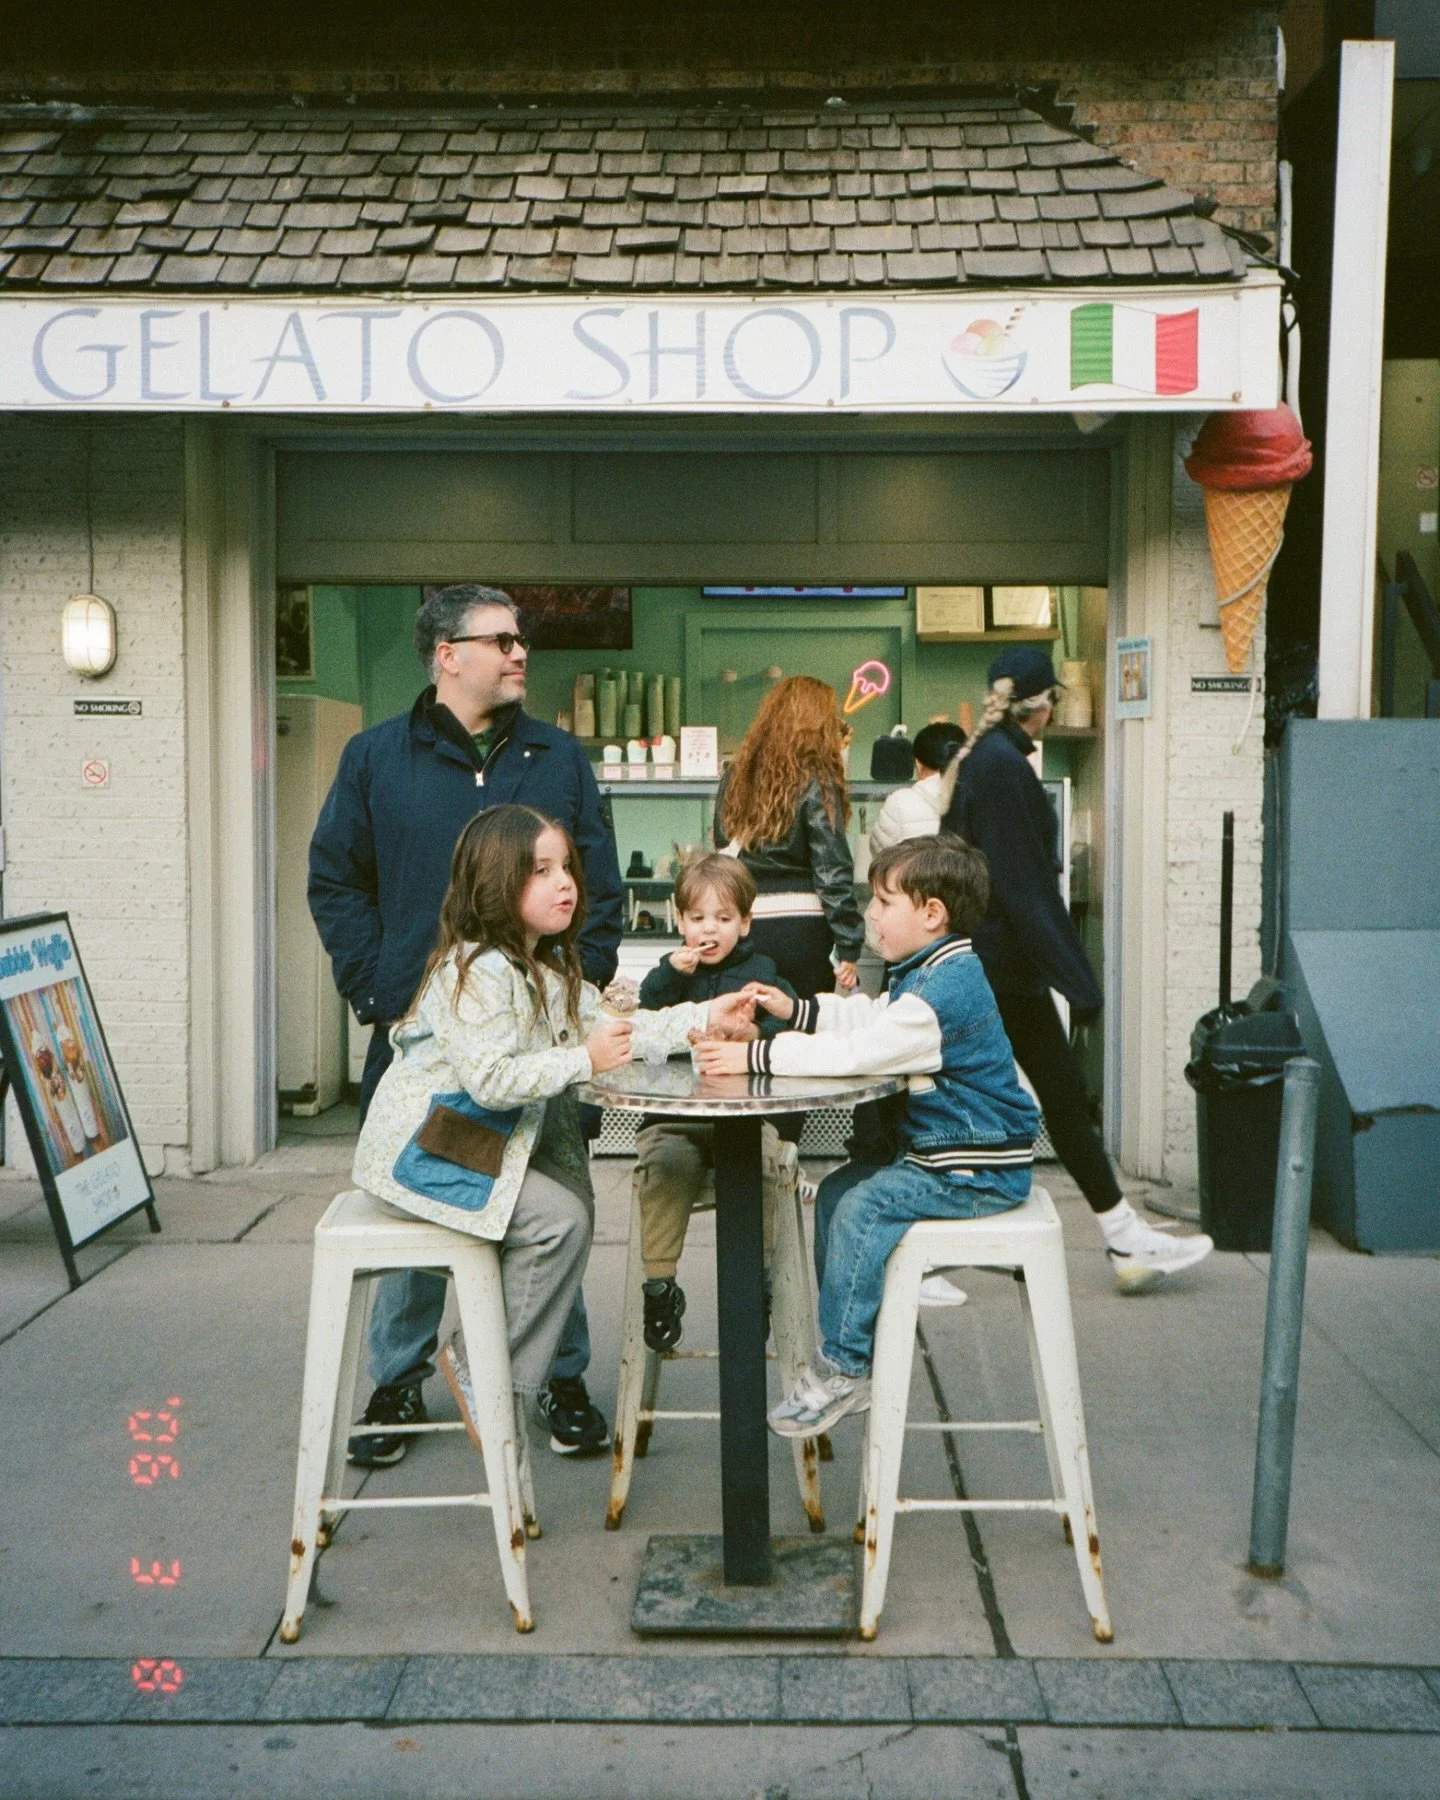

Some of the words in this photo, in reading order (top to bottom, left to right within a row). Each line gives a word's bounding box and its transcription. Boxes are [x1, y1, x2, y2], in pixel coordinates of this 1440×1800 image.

[32, 307, 505, 402] GELATO
[563, 307, 896, 401] SHOP
[1191, 681, 1206, 689] NO
[1207, 681, 1248, 689] SMOKING
[75, 704, 88, 712] NO
[90, 704, 127, 712] SMOKING
